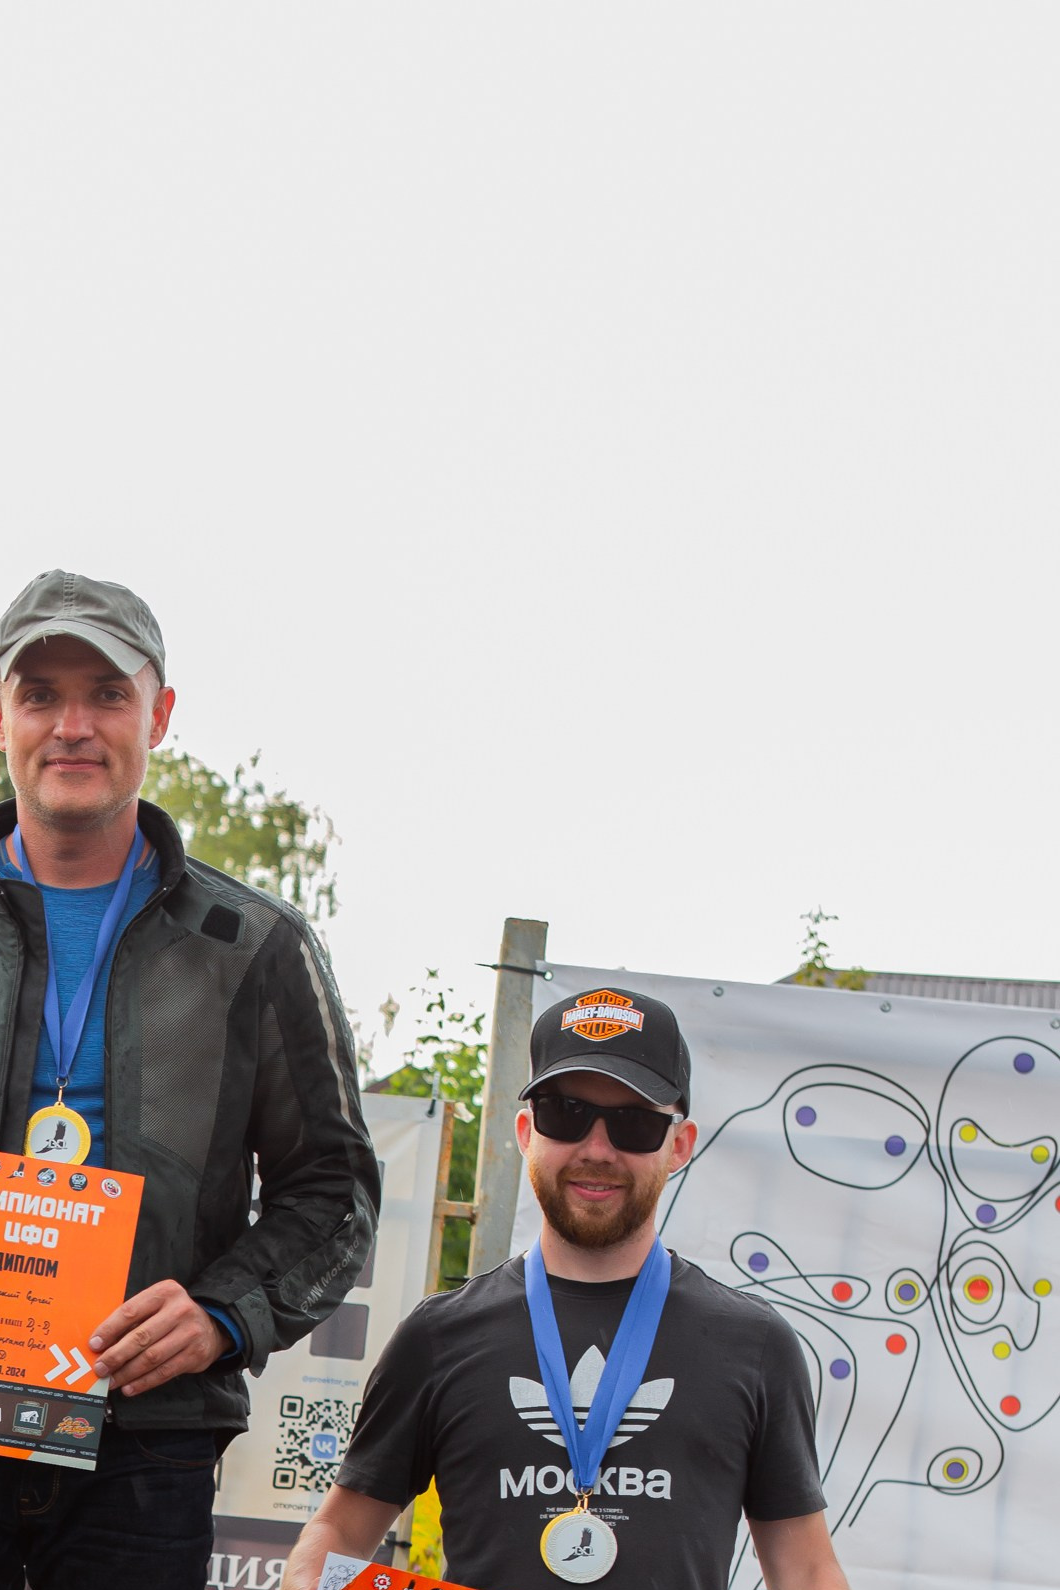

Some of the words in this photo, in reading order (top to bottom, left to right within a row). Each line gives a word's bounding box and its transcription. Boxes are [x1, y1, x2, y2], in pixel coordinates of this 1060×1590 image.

[565, 1006, 640, 1025] HARLEY-DAVIDSON
[580, 1022, 620, 1036] CYCLES
[4, 1221, 59, 1248] ЦФО
[5, 1366, 26, 1378] 2024
